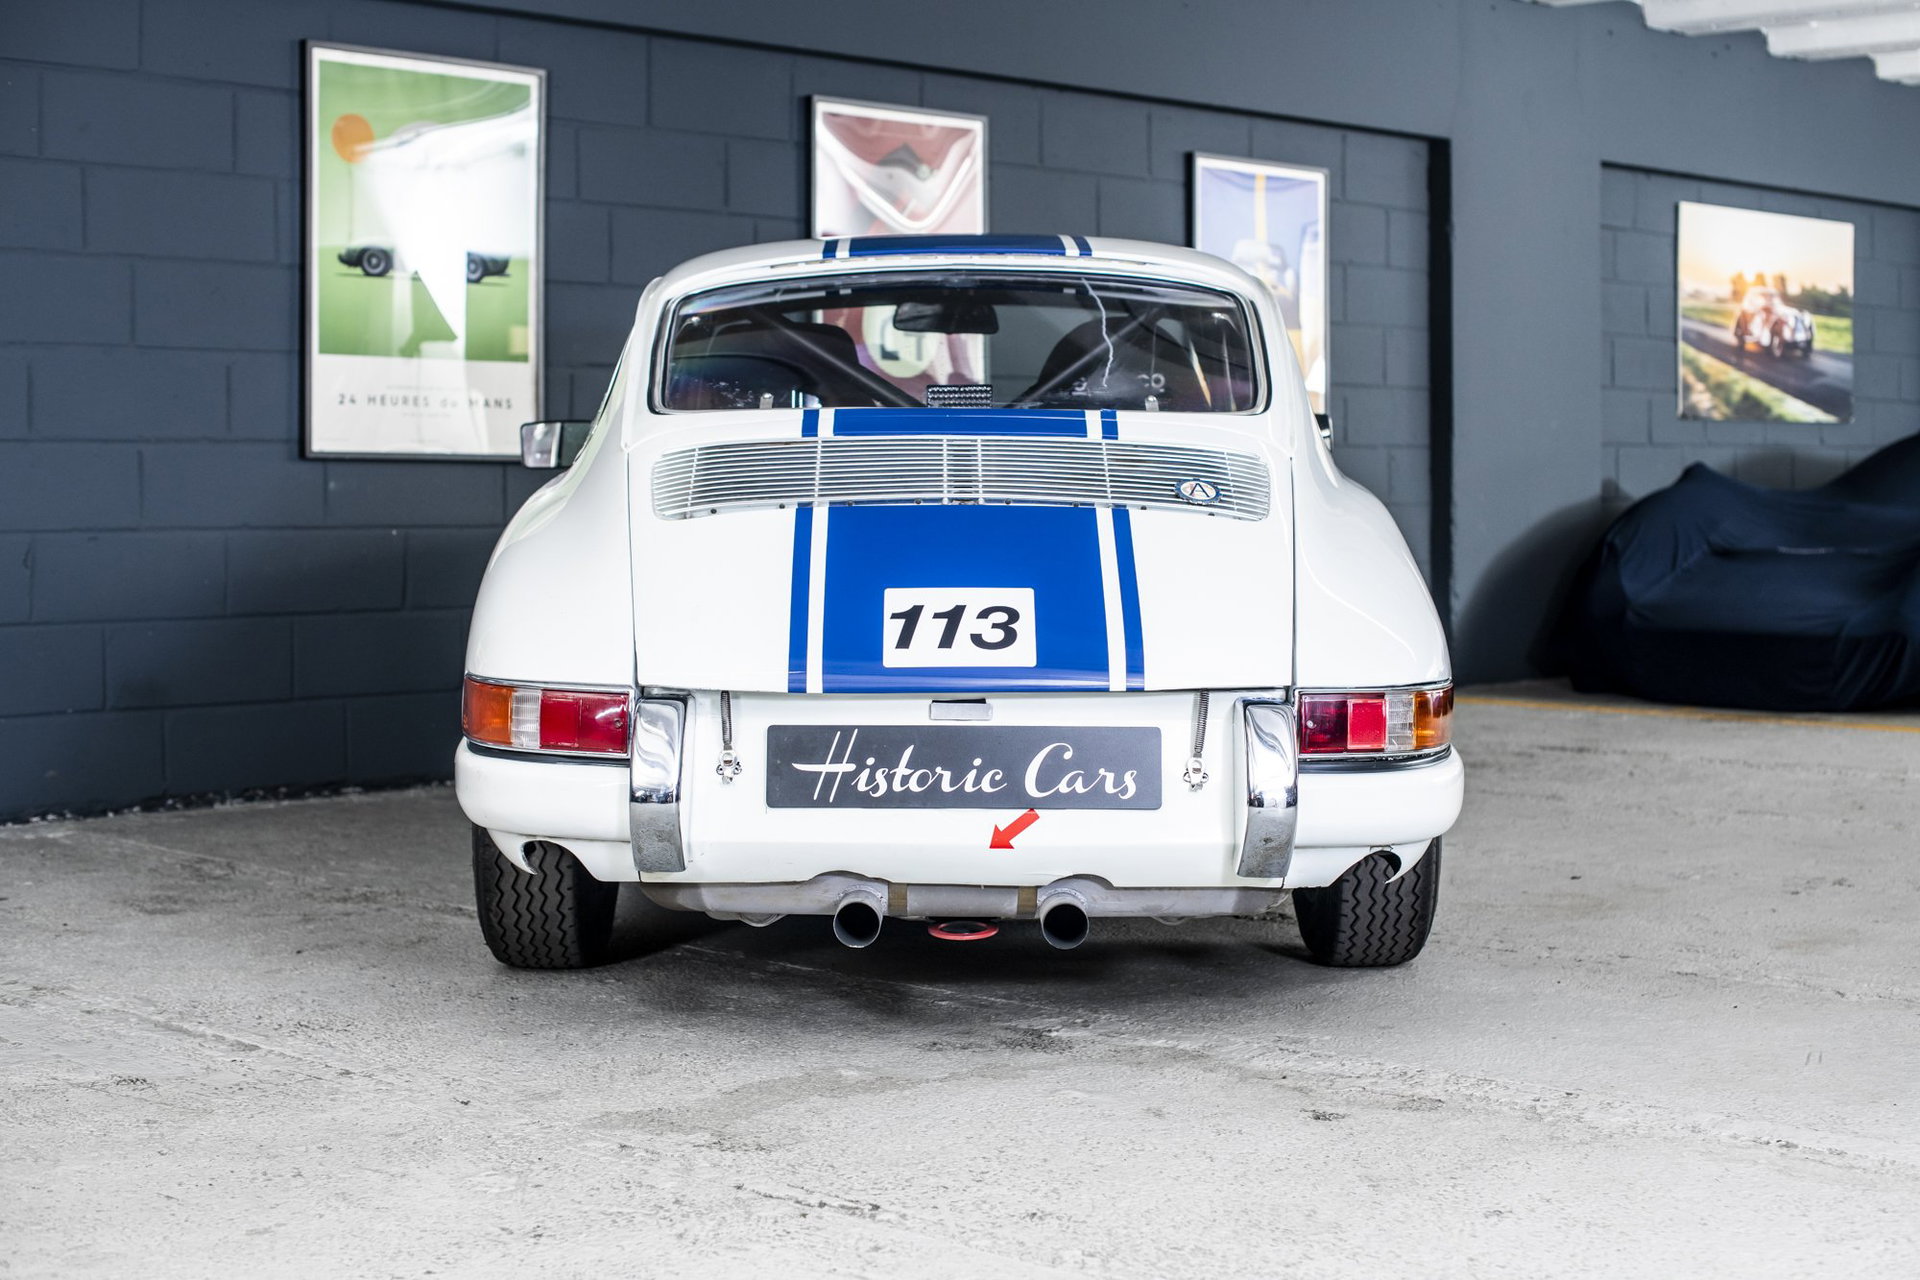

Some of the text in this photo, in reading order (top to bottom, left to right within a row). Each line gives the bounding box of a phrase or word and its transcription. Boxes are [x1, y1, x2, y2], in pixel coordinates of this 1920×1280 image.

[338, 393, 356, 405] 24
[367, 394, 430, 408] HEURES
[889, 604, 1021, 650] 113
[791, 728, 1138, 803] Historic Cars
